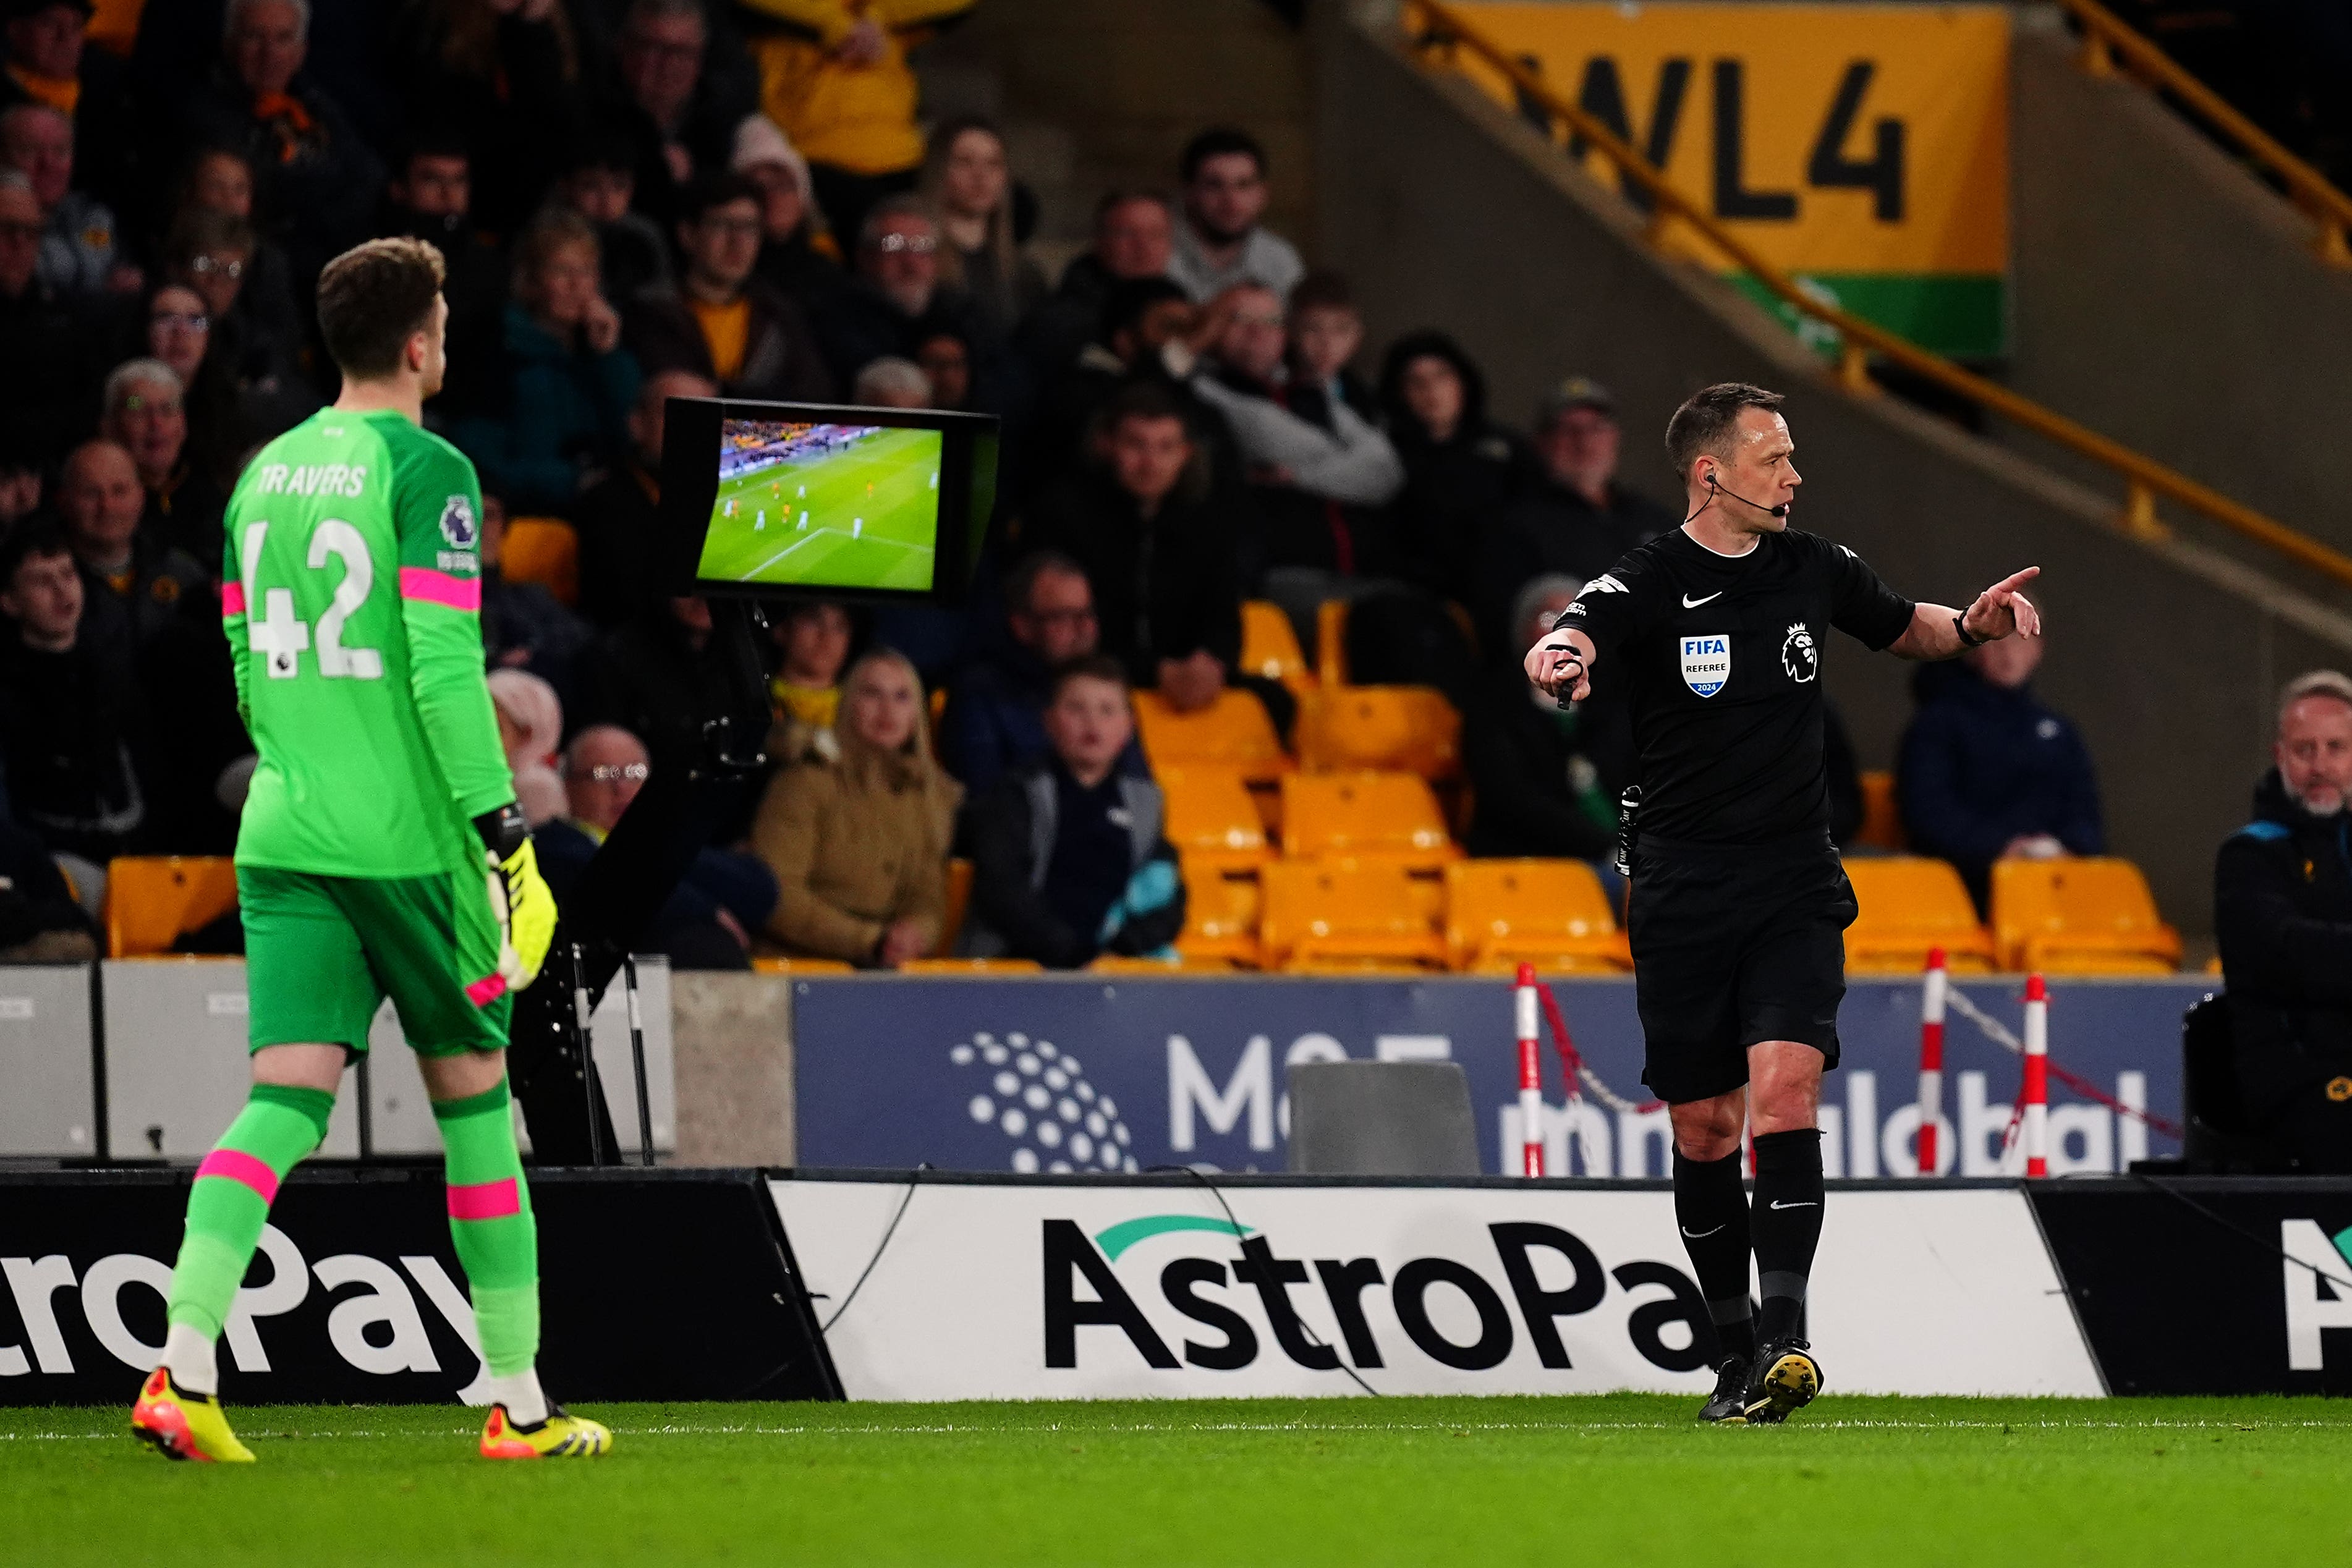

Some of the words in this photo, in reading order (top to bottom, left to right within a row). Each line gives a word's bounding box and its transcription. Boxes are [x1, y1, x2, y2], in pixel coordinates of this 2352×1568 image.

[256, 464, 367, 499] TRAVERS
[242, 517, 384, 679] 42
[1685, 639, 1726, 655] FIFA
[1685, 663, 1726, 673] REFEREE
[1697, 684, 1717, 692] 2024
[1043, 1219, 1806, 1372] AstroPa
